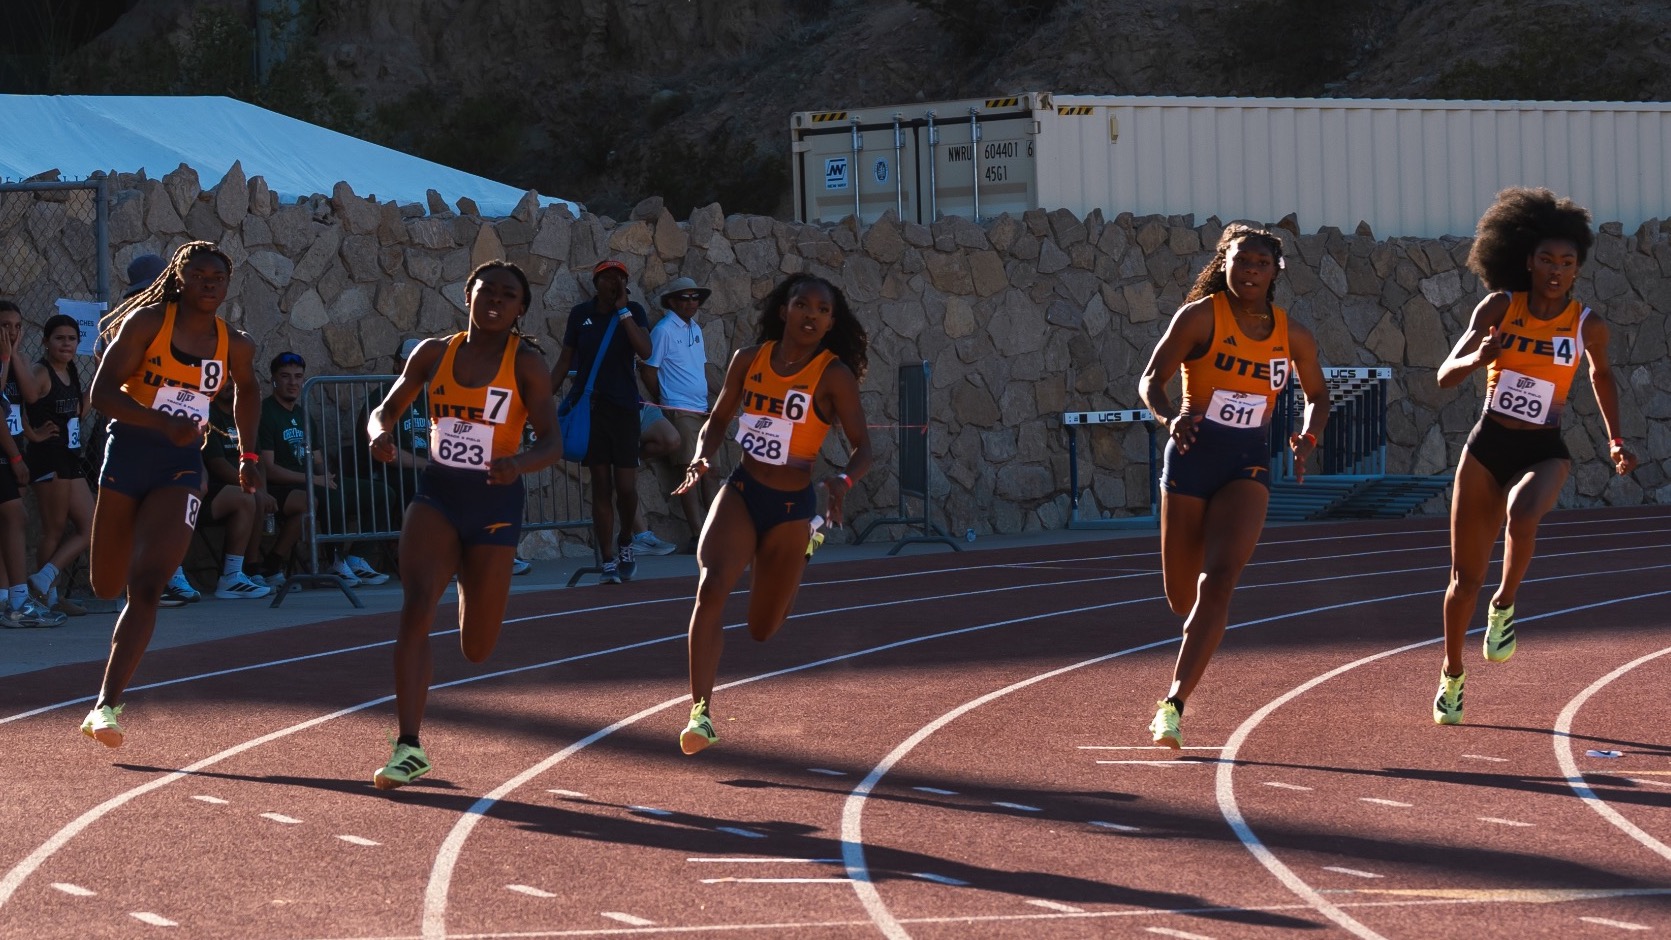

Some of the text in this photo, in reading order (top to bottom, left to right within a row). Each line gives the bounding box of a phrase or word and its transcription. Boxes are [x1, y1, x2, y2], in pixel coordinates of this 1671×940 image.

[948, 141, 1034, 162] NWRU 604401 6
[985, 166, 1007, 181] 45G1
[1501, 332, 1554, 357] UTE
[1556, 338, 1573, 365] 4
[203, 361, 221, 390] 8
[1214, 352, 1271, 381] UTE
[1272, 360, 1286, 388] 5
[1330, 369, 1357, 379] UCS
[176, 389, 196, 403] UTEP
[487, 389, 509, 420] 7
[743, 389, 784, 415] UTE
[785, 392, 806, 421] 6
[1498, 391, 1543, 419] 629
[434, 404, 483, 420] UTE
[1098, 412, 1122, 423] UCS
[1219, 403, 1255, 426] 611
[453, 421, 472, 434] UTEP
[438, 438, 484, 466] 623
[740, 431, 782, 460] 628
[188, 498, 199, 527] 8
